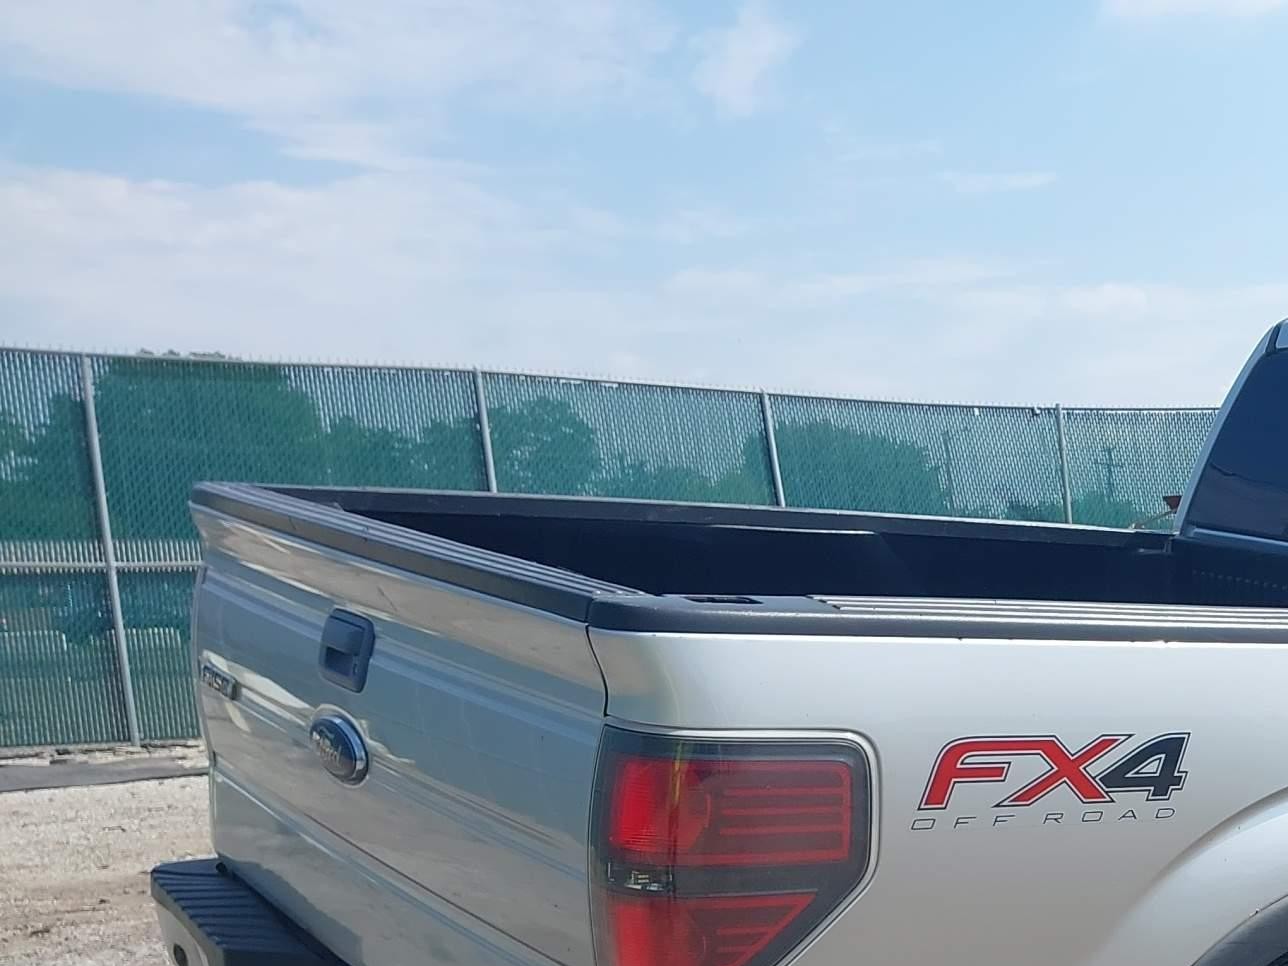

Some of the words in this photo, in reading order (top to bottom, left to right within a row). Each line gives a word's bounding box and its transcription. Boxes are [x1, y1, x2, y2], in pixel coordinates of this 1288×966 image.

[917, 732, 1191, 810] FX4
[911, 814, 1016, 831] OFF
[1042, 807, 1176, 825] ROAD
